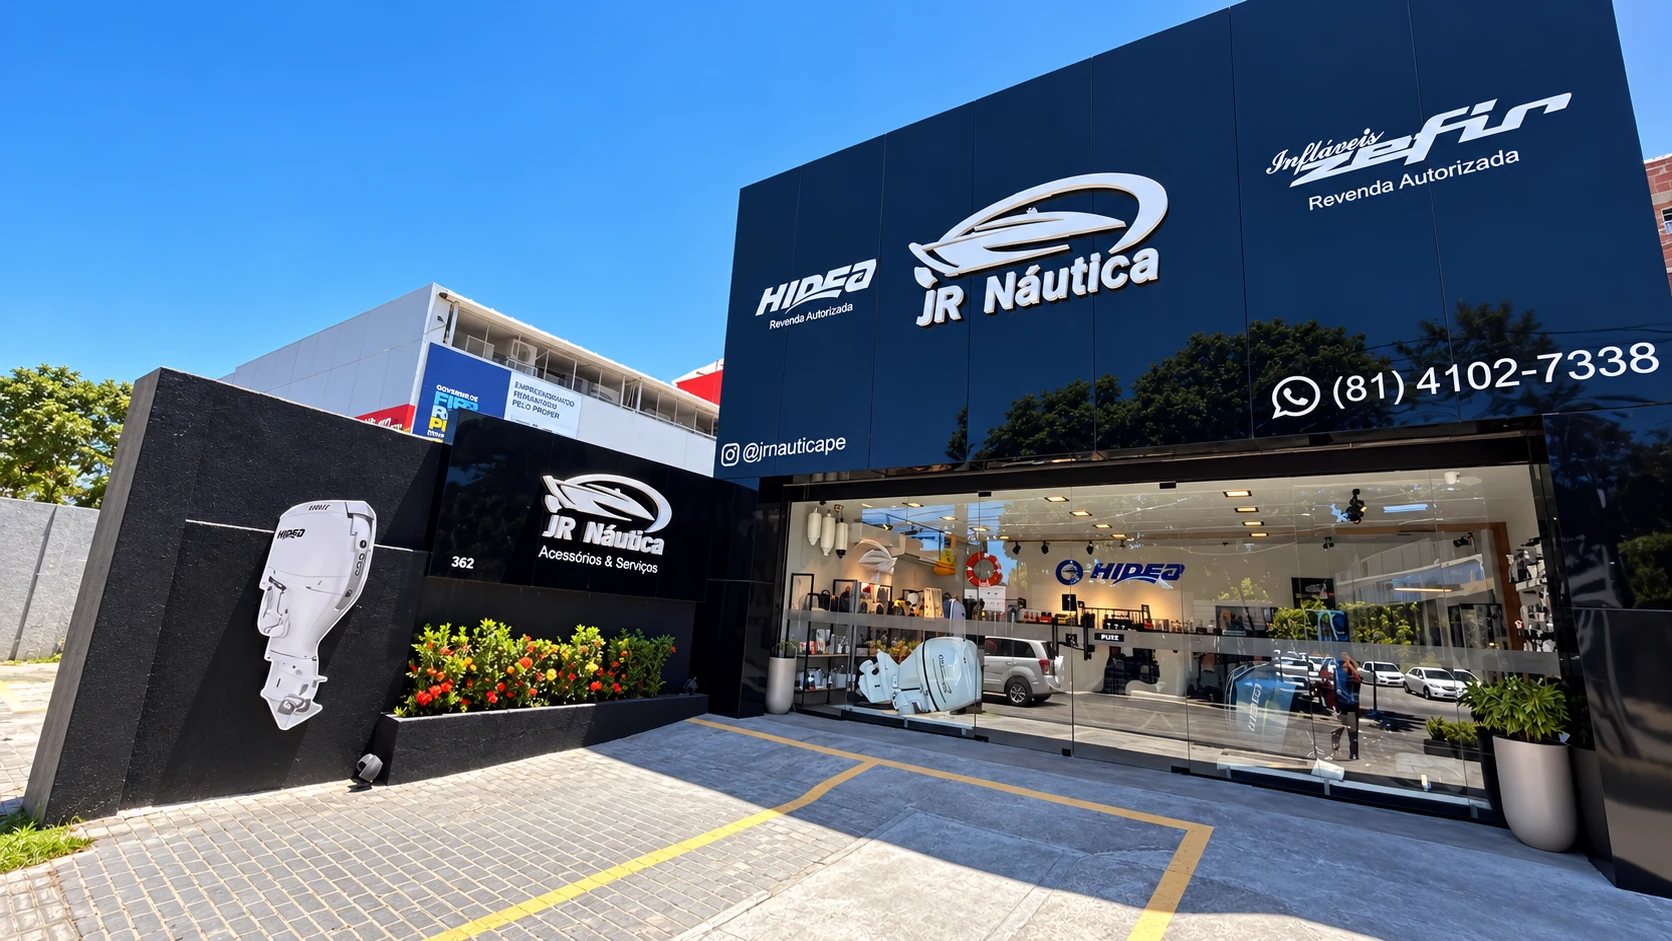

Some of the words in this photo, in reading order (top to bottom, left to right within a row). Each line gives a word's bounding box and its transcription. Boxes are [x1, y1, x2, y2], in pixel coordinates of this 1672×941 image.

[1265, 127, 1385, 176] Infláveis
[1308, 180, 1394, 211] Revenda
[1399, 149, 1520, 190] Autorizada
[755, 258, 877, 316] HIDEA
[915, 285, 965, 327] JR
[982, 247, 1161, 314] Náutica
[769, 314, 805, 330] Revenda
[805, 302, 854, 321] Autorizada
[1333, 370, 1405, 410] (81)
[1416, 342, 1660, 395] 4102-7338
[742, 437, 847, 463] @jrnauticape
[541, 514, 577, 541] JR
[582, 521, 665, 555] Náutica
[451, 555, 475, 570] 362
[538, 545, 602, 567] Acessórios
[604, 555, 613, 568] &
[615, 557, 658, 574] Serviços
[1089, 562, 1185, 585] HIDEA
